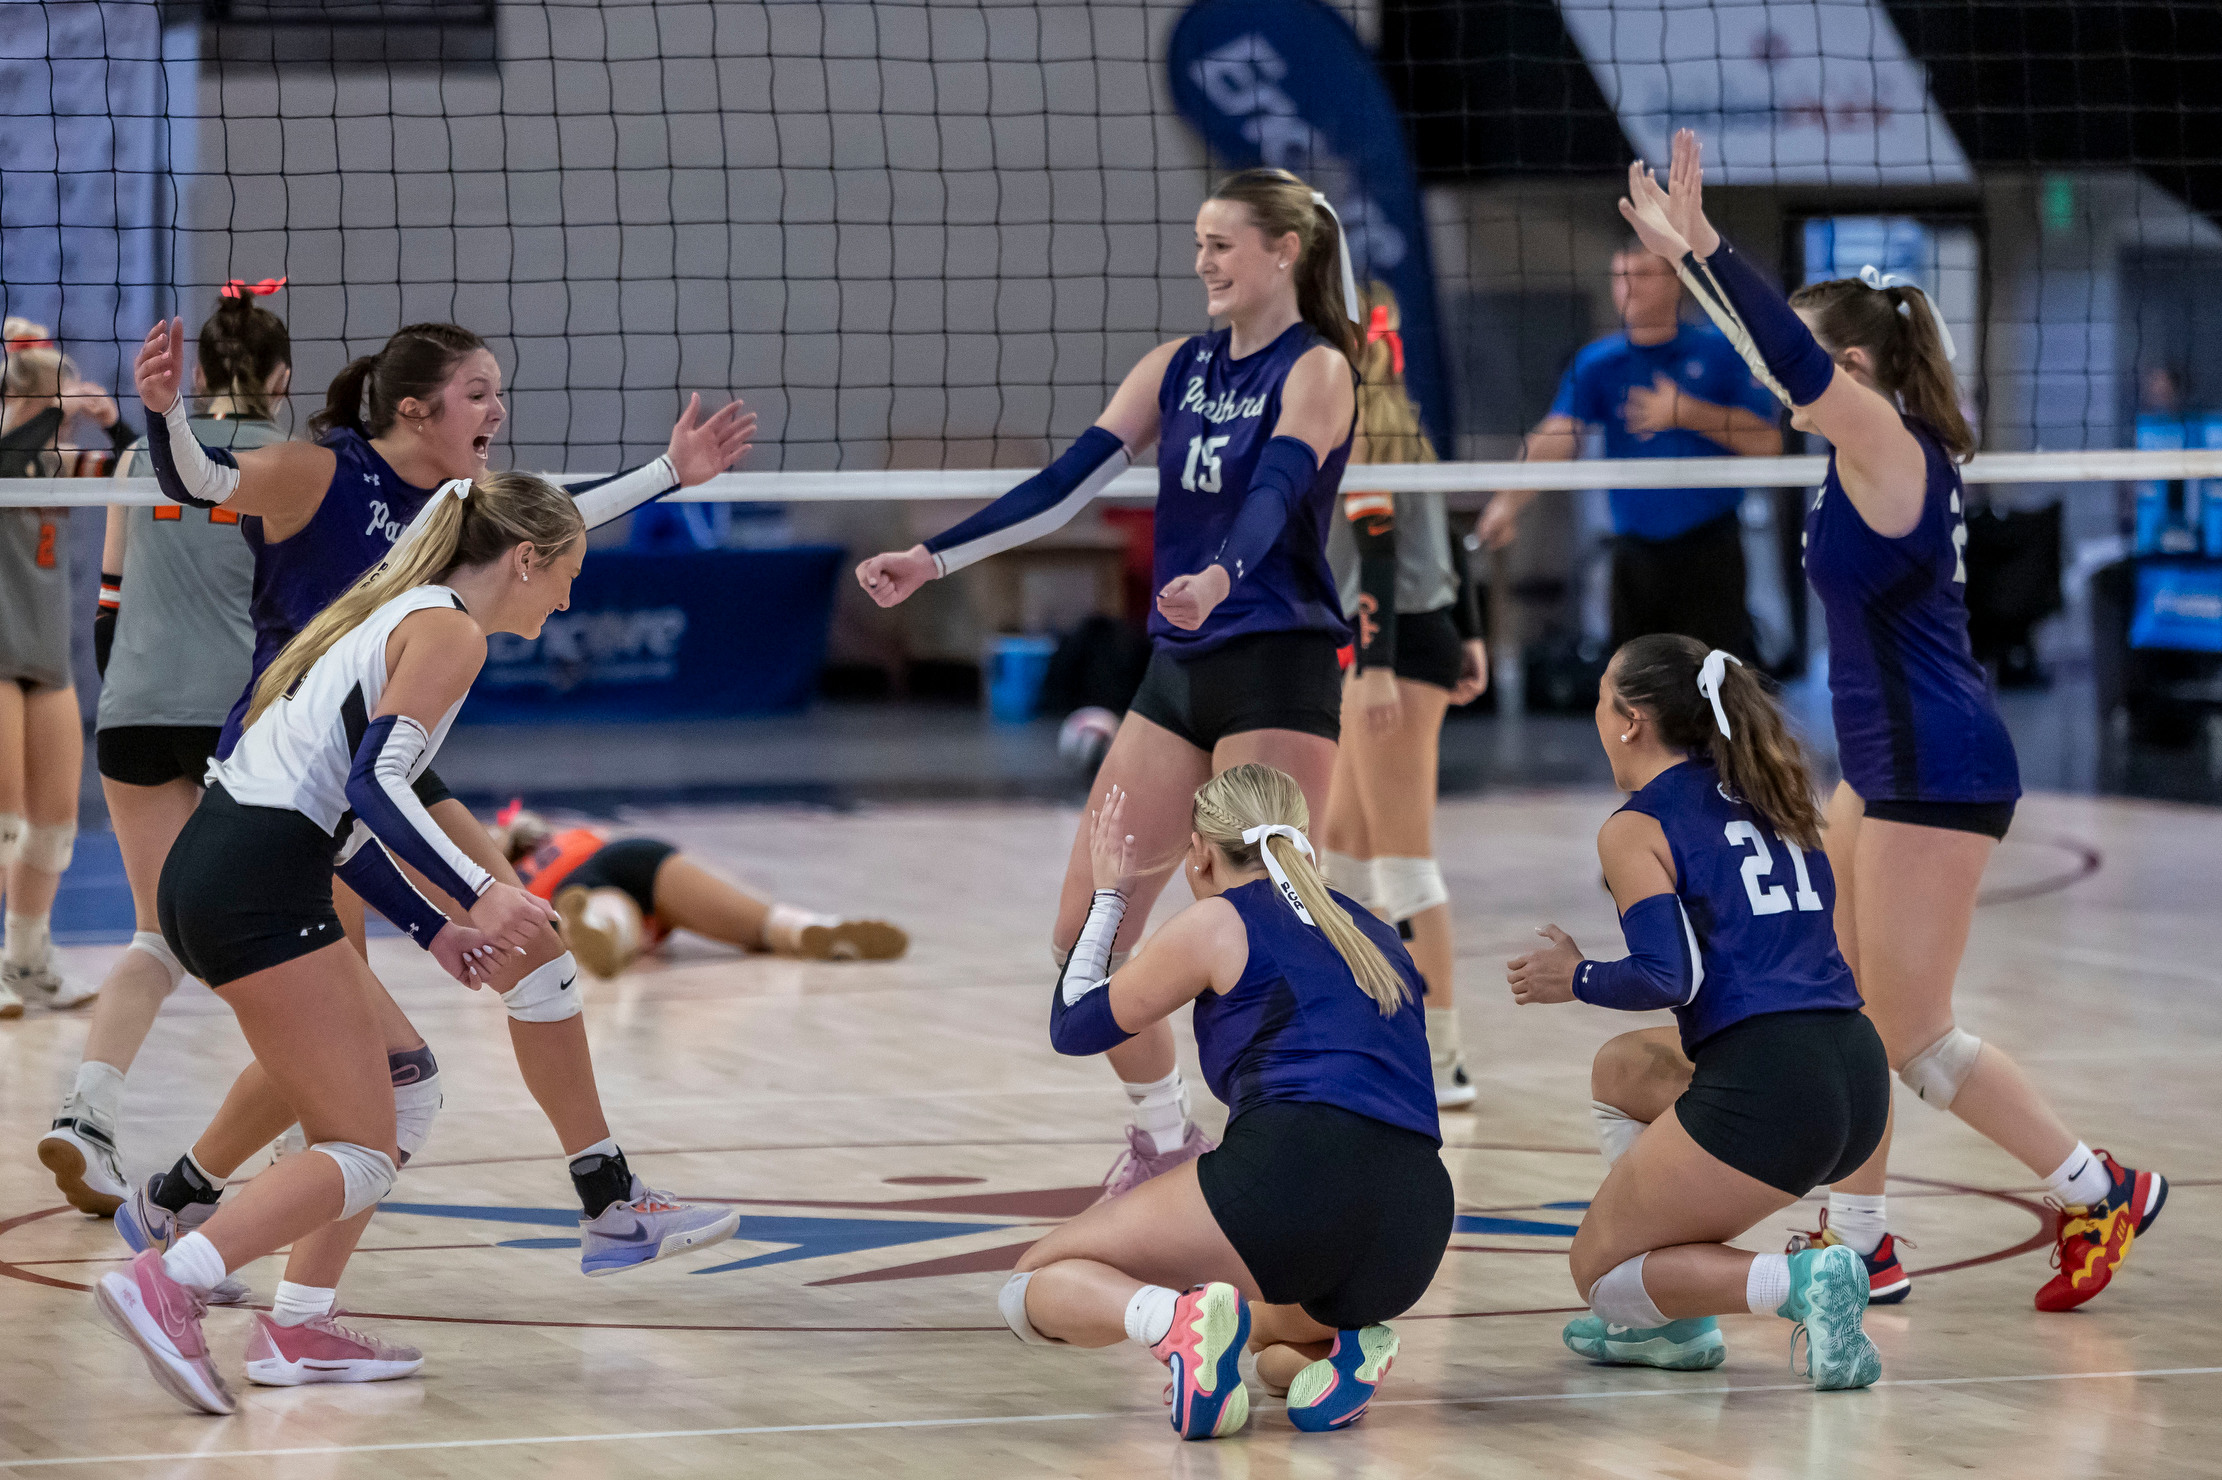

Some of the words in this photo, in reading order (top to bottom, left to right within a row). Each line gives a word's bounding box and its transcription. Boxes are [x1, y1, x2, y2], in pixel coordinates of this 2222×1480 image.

[1178, 375, 1268, 425] Panthrs
[1180, 434, 1231, 494] 15
[364, 499, 409, 544] Pa
[1723, 820, 1824, 916] 21
[1280, 881, 1305, 911] PCA
